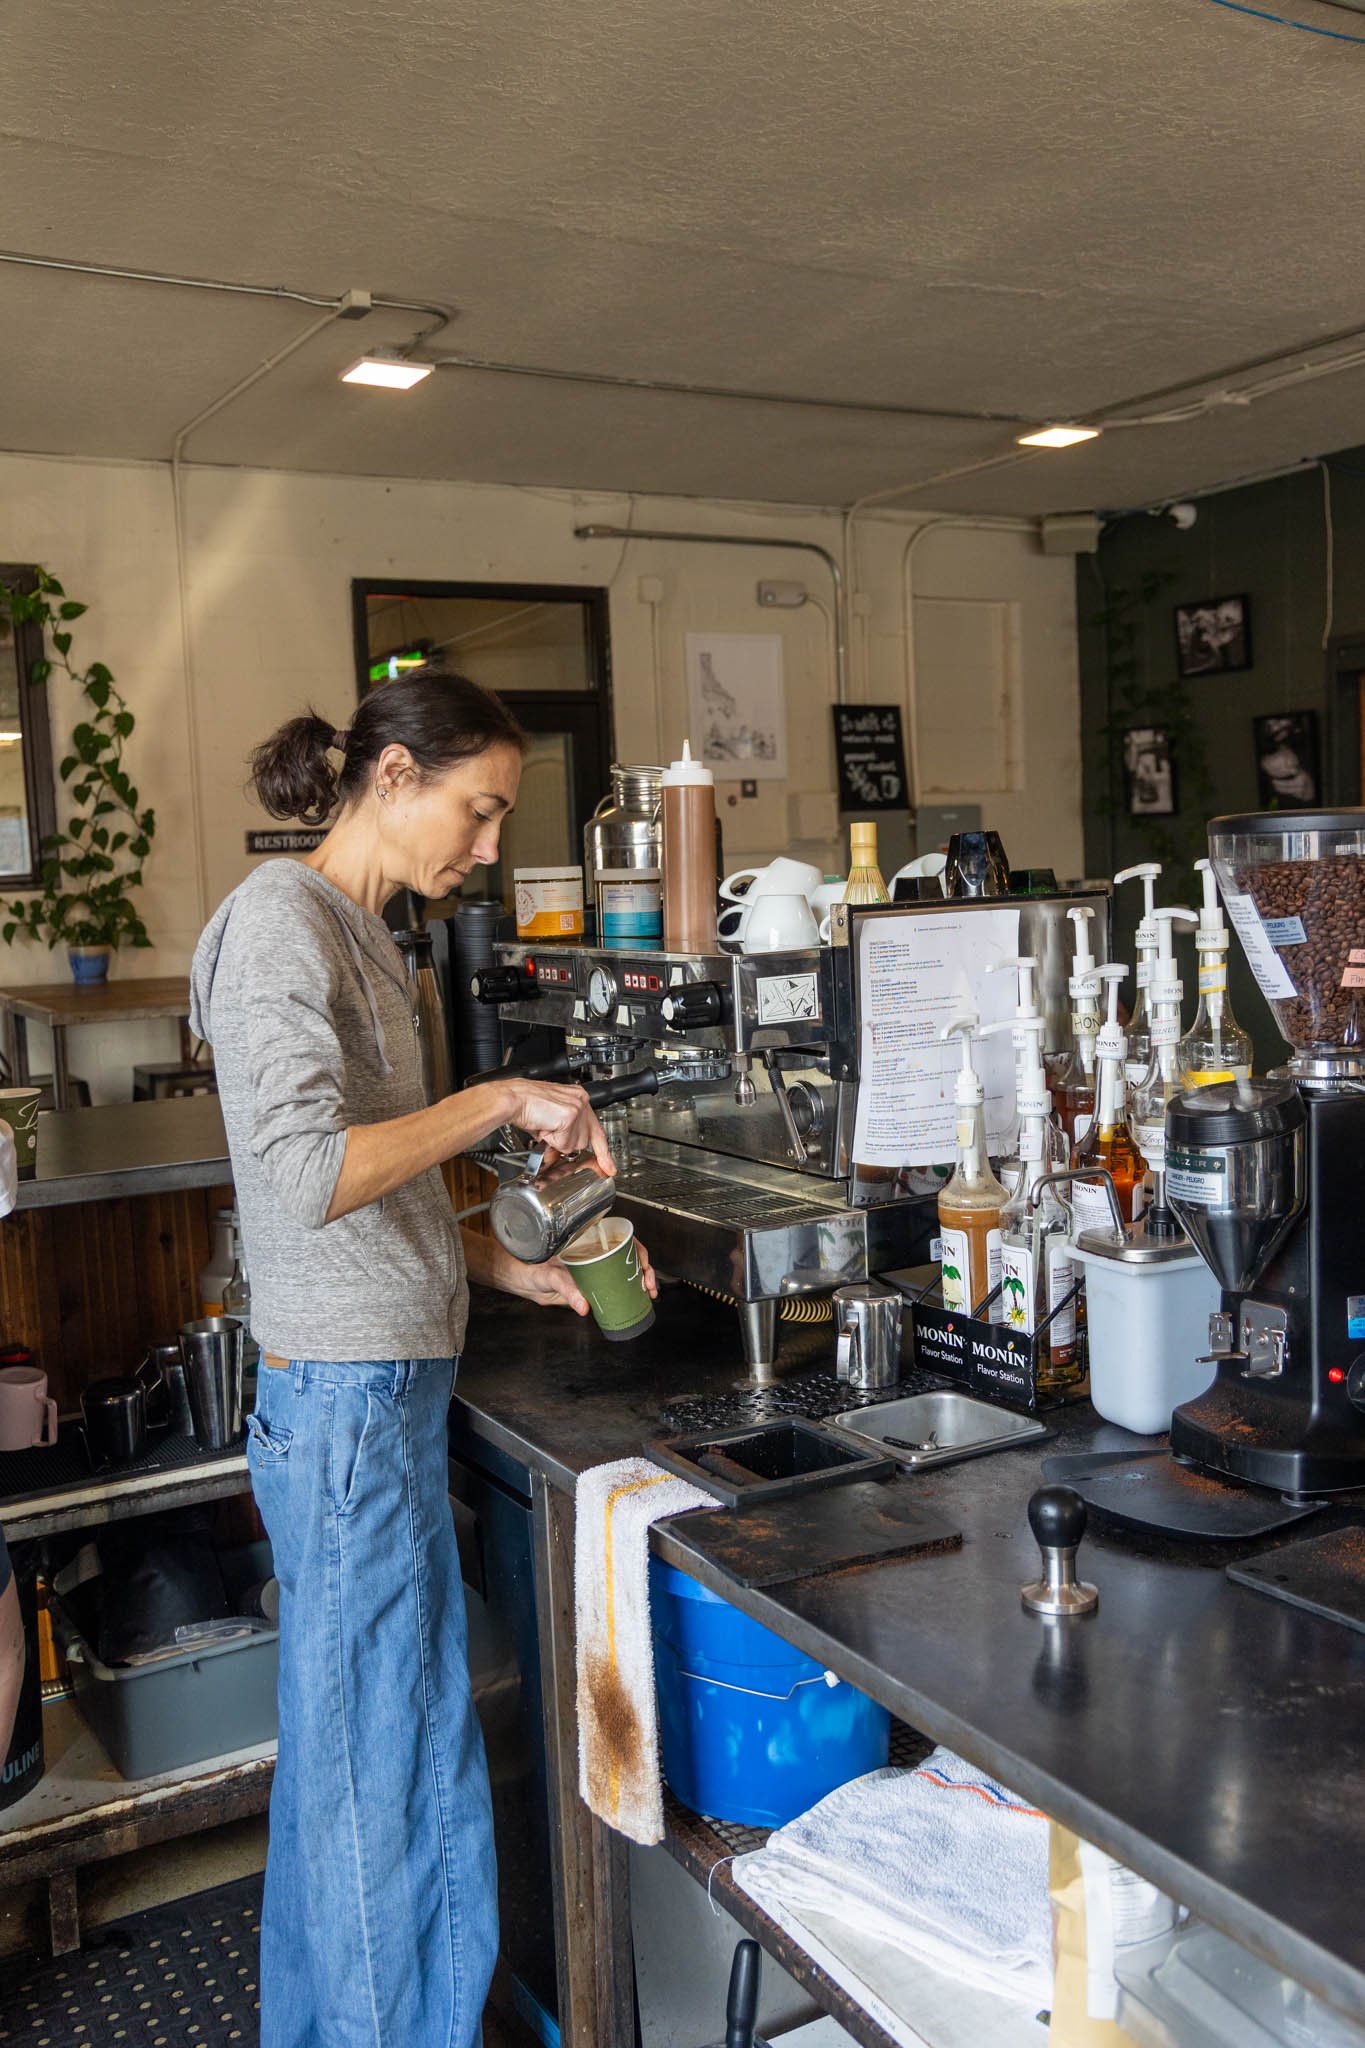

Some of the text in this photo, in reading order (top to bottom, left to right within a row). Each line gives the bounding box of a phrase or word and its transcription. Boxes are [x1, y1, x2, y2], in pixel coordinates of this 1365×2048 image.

[916, 1323, 964, 1349] MONIN
[921, 1345, 964, 1365] Flavor Station
[972, 1341, 1026, 1368] MONIN
[977, 1363, 1025, 1385] Flavor Station
